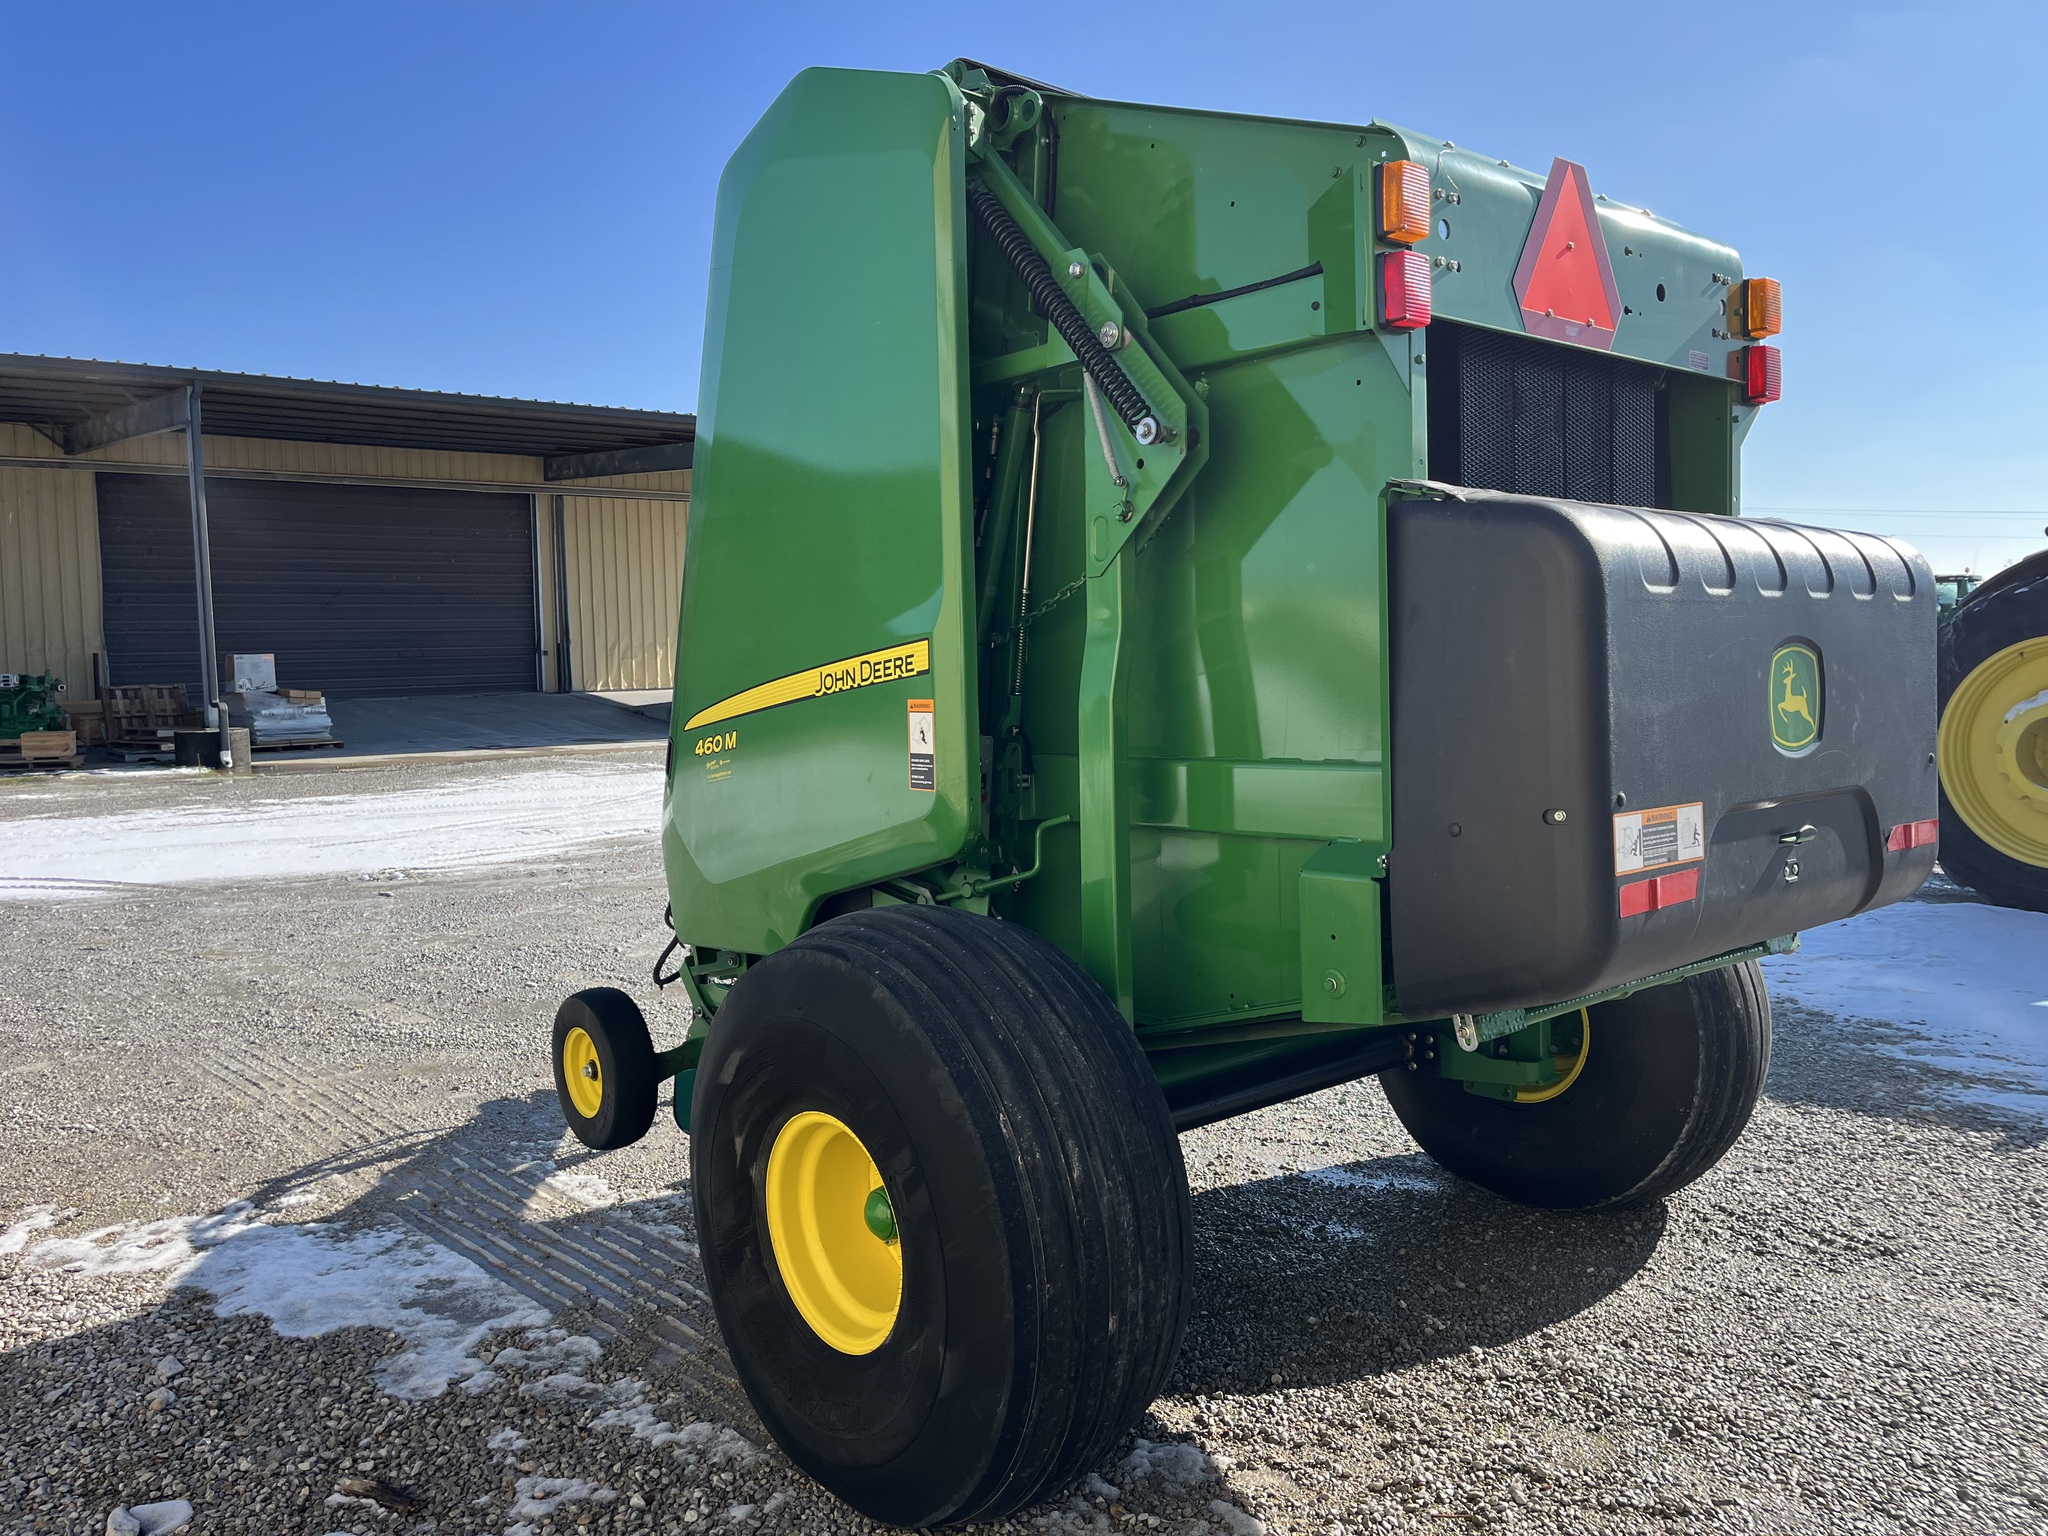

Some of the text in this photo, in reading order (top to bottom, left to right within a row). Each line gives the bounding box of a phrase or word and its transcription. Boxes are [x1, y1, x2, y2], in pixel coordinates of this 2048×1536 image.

[815, 653, 915, 694] JOHN DEERE
[1650, 812, 1672, 822] WARNING
